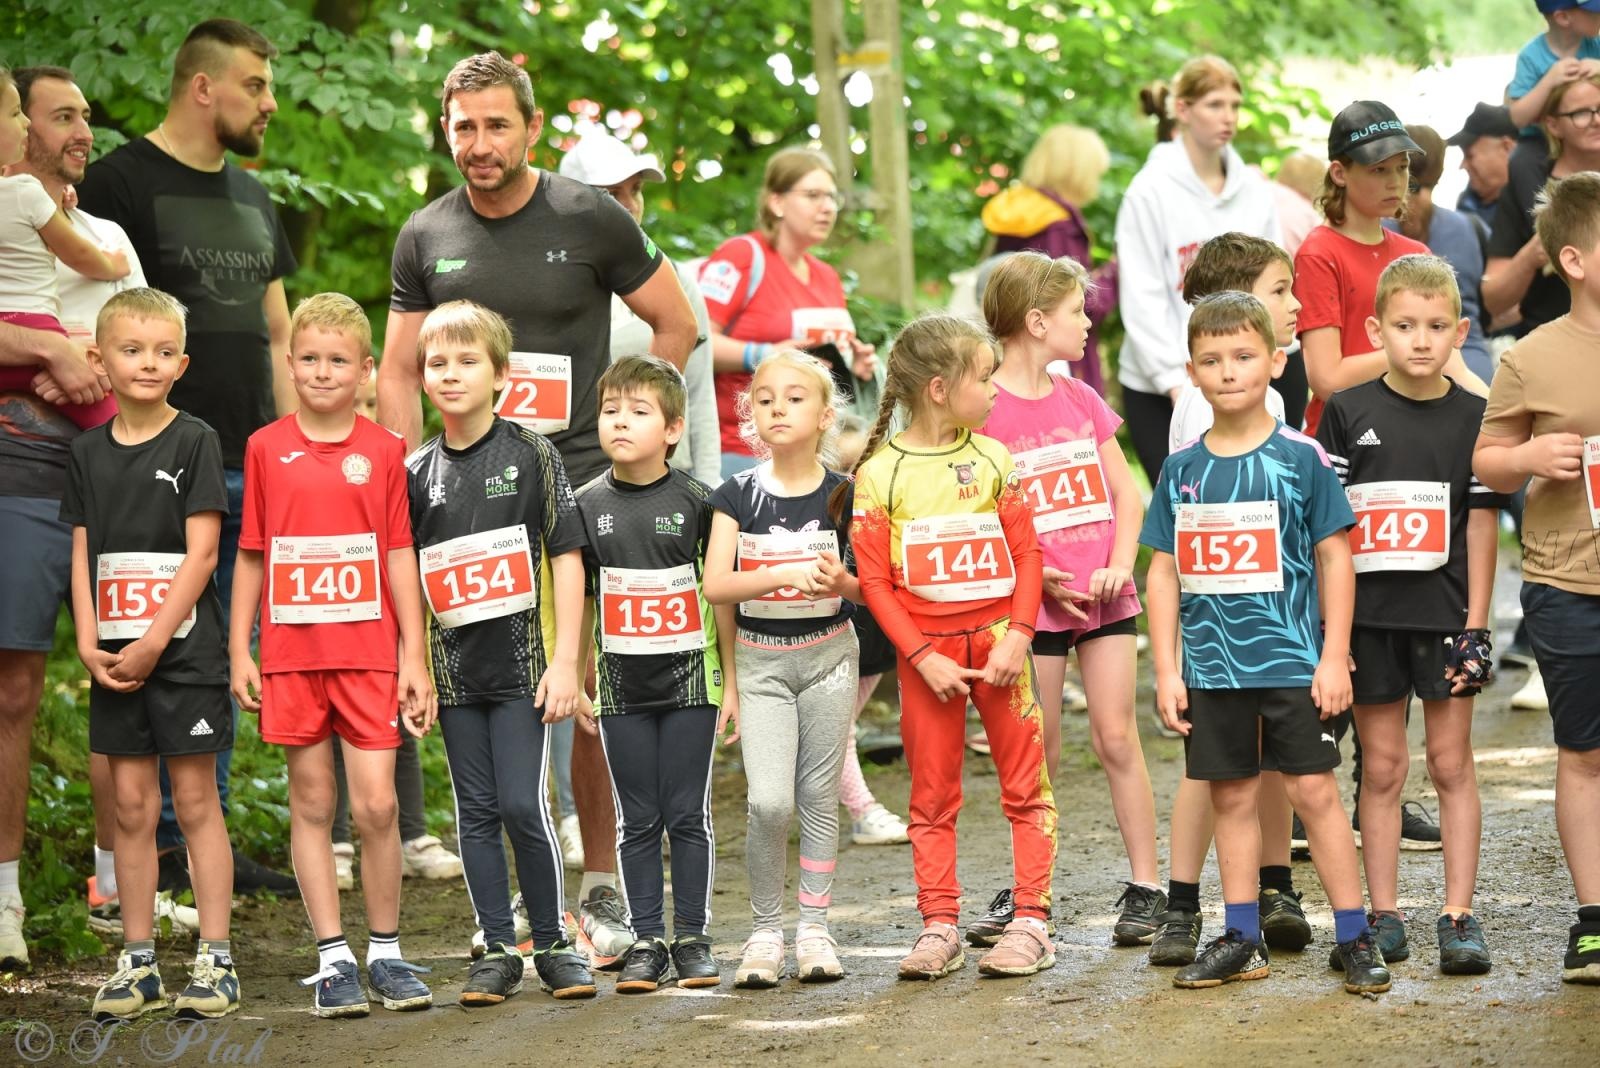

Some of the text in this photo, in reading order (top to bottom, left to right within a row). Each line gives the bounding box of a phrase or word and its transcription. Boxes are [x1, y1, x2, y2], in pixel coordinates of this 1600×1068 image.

[537, 365, 557, 374] 4500
[1073, 451, 1089, 460] 4500
[486, 482, 517, 496] MORE
[957, 485, 979, 501] ALA
[1027, 469, 1097, 513] 141
[1411, 494, 1434, 503] 4500
[1435, 495, 1444, 503] M
[1240, 515, 1262, 523] 4500
[656, 525, 682, 534] MORE
[979, 523, 994, 532] 4500
[994, 523, 1000, 531] M
[1358, 511, 1429, 551] 149
[278, 543, 295, 554] Bieg
[345, 546, 364, 555] 4500
[365, 545, 373, 553] M
[427, 551, 443, 560] Bieg
[492, 540, 514, 550] 4500
[514, 537, 524, 546] M
[807, 543, 826, 551] 4500
[827, 542, 835, 550] M
[1190, 533, 1260, 572] 152
[926, 542, 999, 582] 144
[289, 565, 362, 602] 140
[442, 558, 516, 606] 154
[607, 574, 623, 585] Bieg
[671, 577, 686, 587] 4500
[686, 575, 694, 584] M
[617, 597, 688, 634] 153
[757, 634, 787, 647] DANCE
[791, 630, 823, 646] DANCE
[190, 728, 214, 736] adidas
